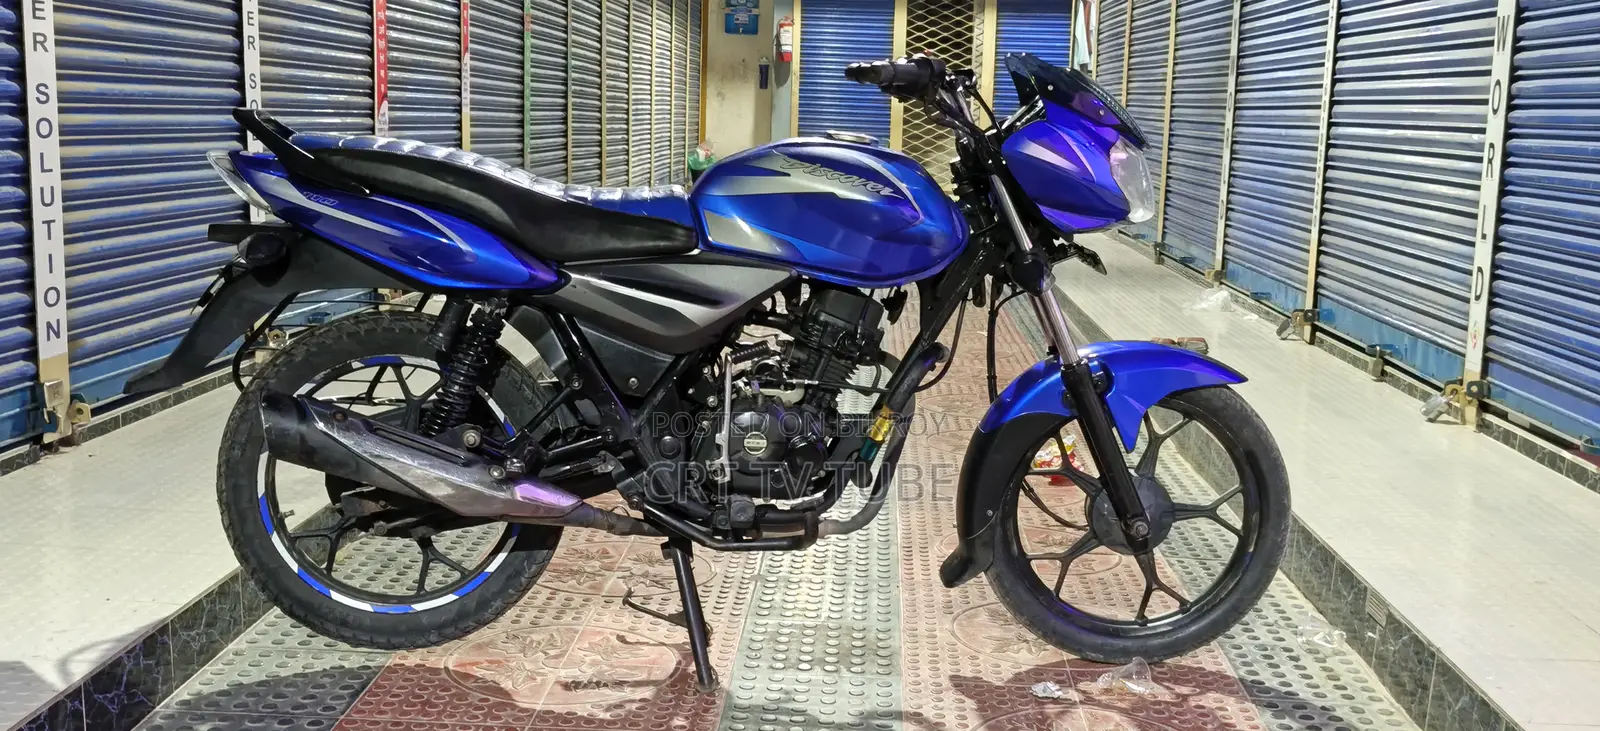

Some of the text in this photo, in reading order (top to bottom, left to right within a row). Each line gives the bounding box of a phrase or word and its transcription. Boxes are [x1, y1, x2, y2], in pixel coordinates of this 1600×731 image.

[247, 0, 256, 50] ER
[35, 83, 61, 342] SOLUTION
[1474, 15, 1510, 302] WORLD
